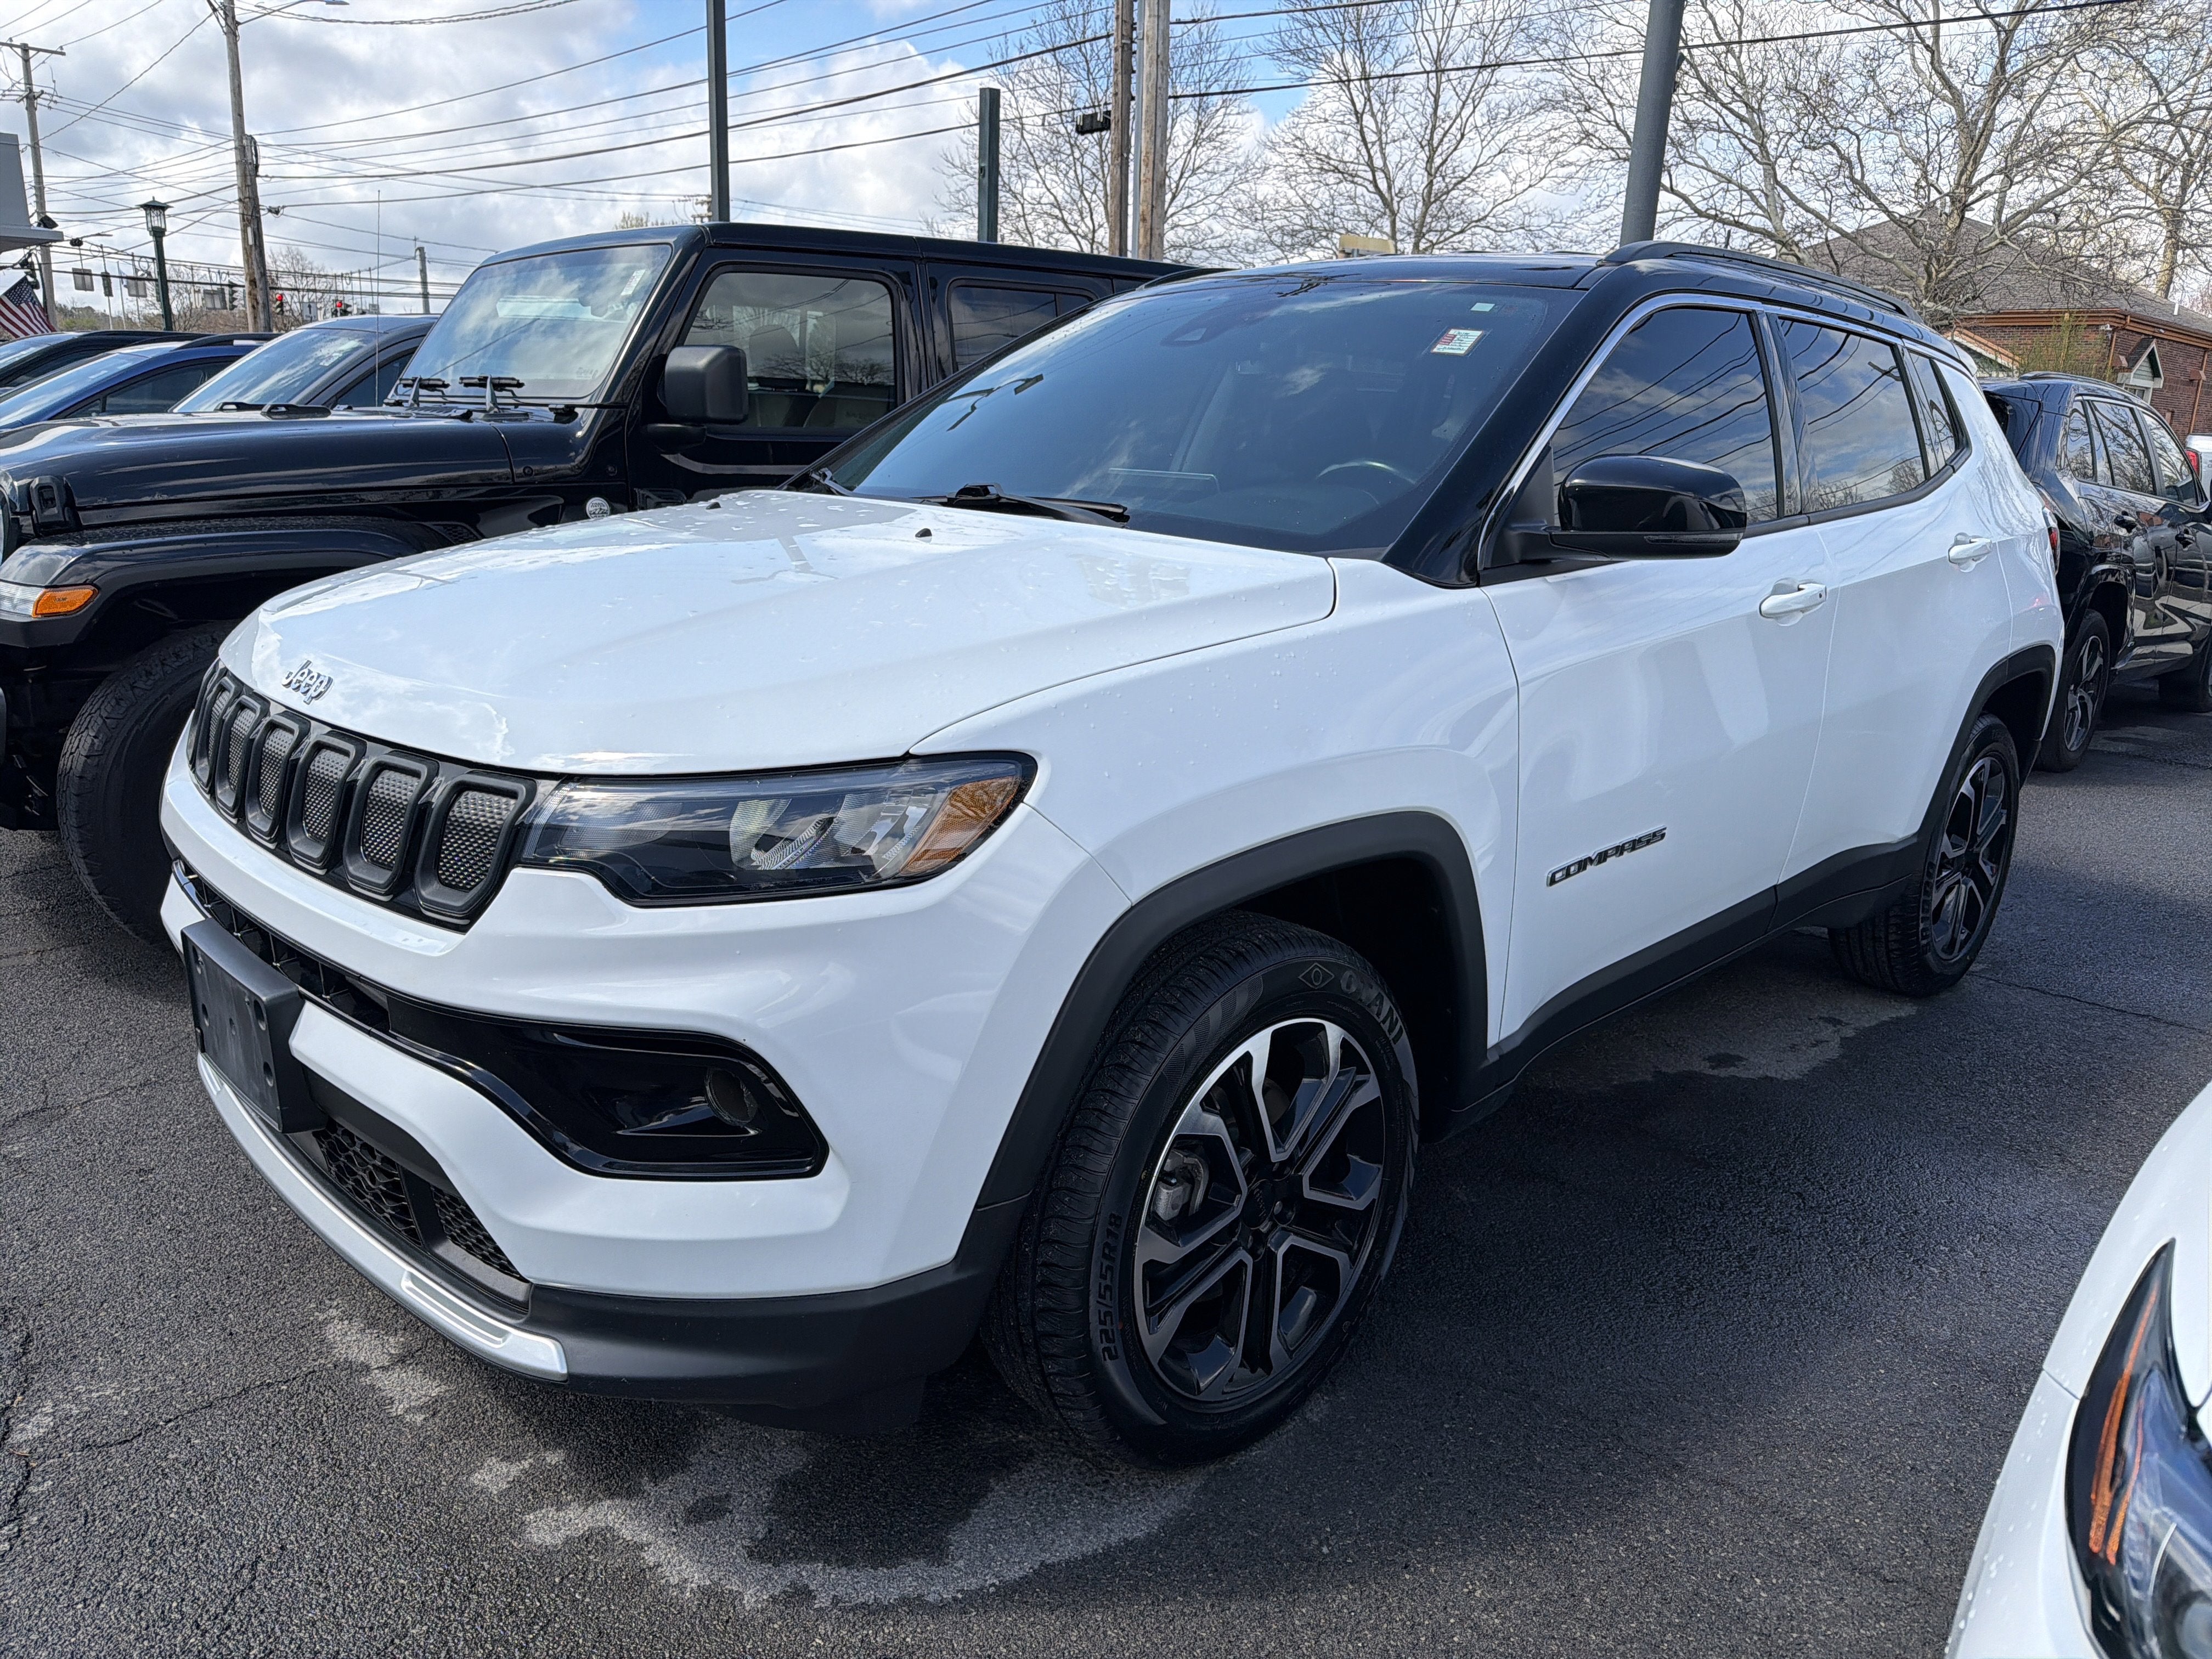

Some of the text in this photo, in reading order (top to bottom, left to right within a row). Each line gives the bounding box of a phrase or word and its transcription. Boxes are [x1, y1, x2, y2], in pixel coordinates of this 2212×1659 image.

[281, 659, 333, 704] Jeep
[1547, 825, 1667, 887] COMPASS
[1340, 970, 1403, 1045] OTANI
[1097, 1212, 1122, 1361] 225/55R18
